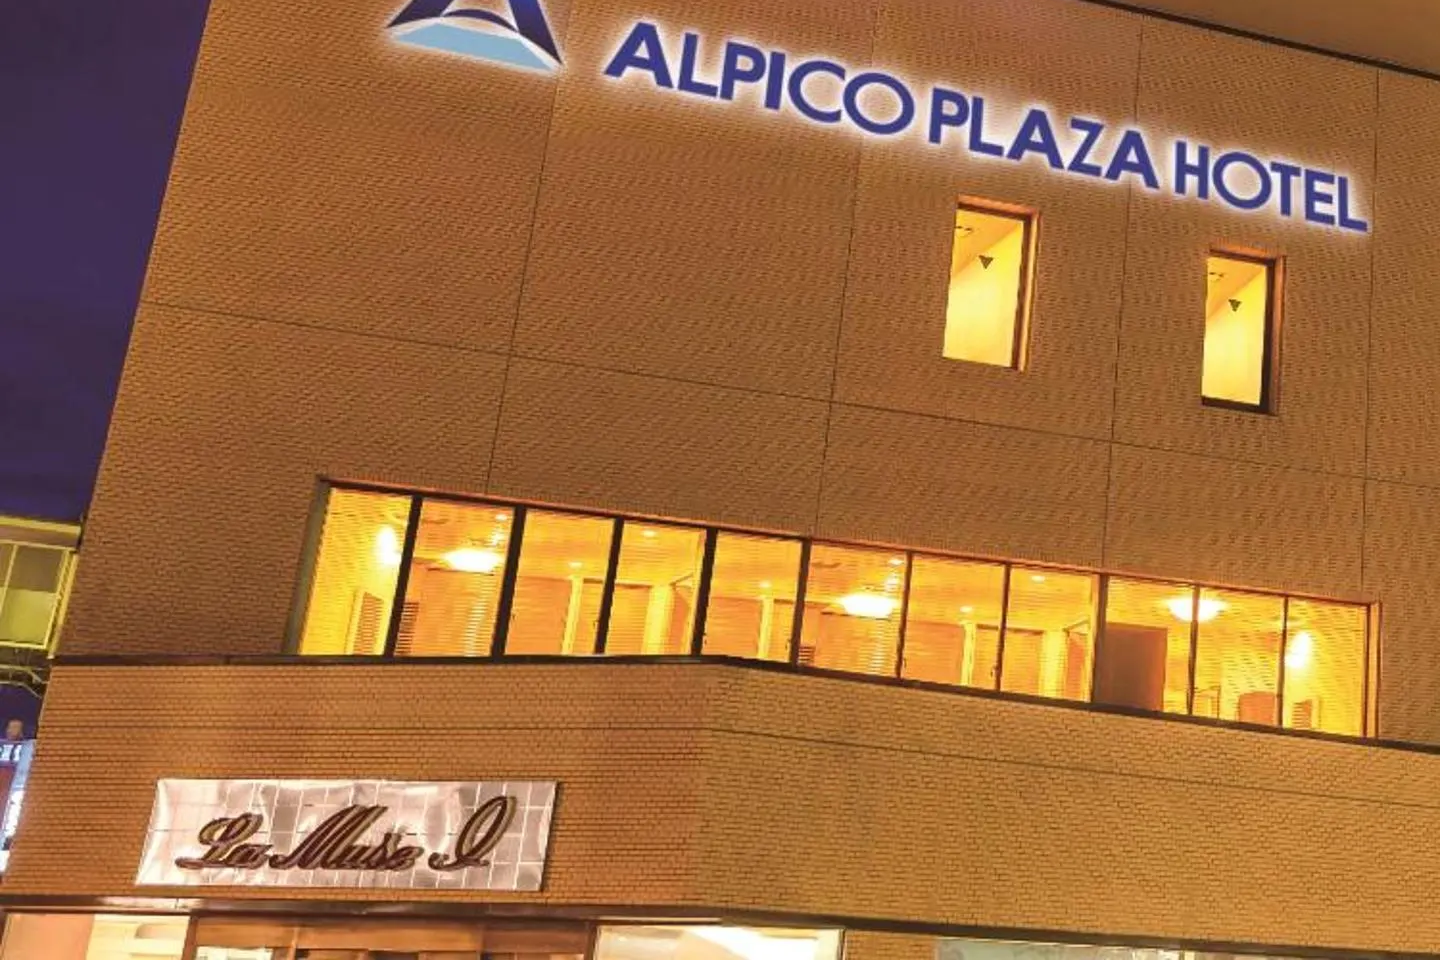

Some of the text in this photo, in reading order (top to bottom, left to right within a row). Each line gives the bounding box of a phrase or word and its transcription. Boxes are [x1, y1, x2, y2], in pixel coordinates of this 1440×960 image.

[604, 21, 1368, 232] ALPICO PLAZA HOTEL
[175, 812, 273, 869] La
[268, 804, 424, 870] Muse
